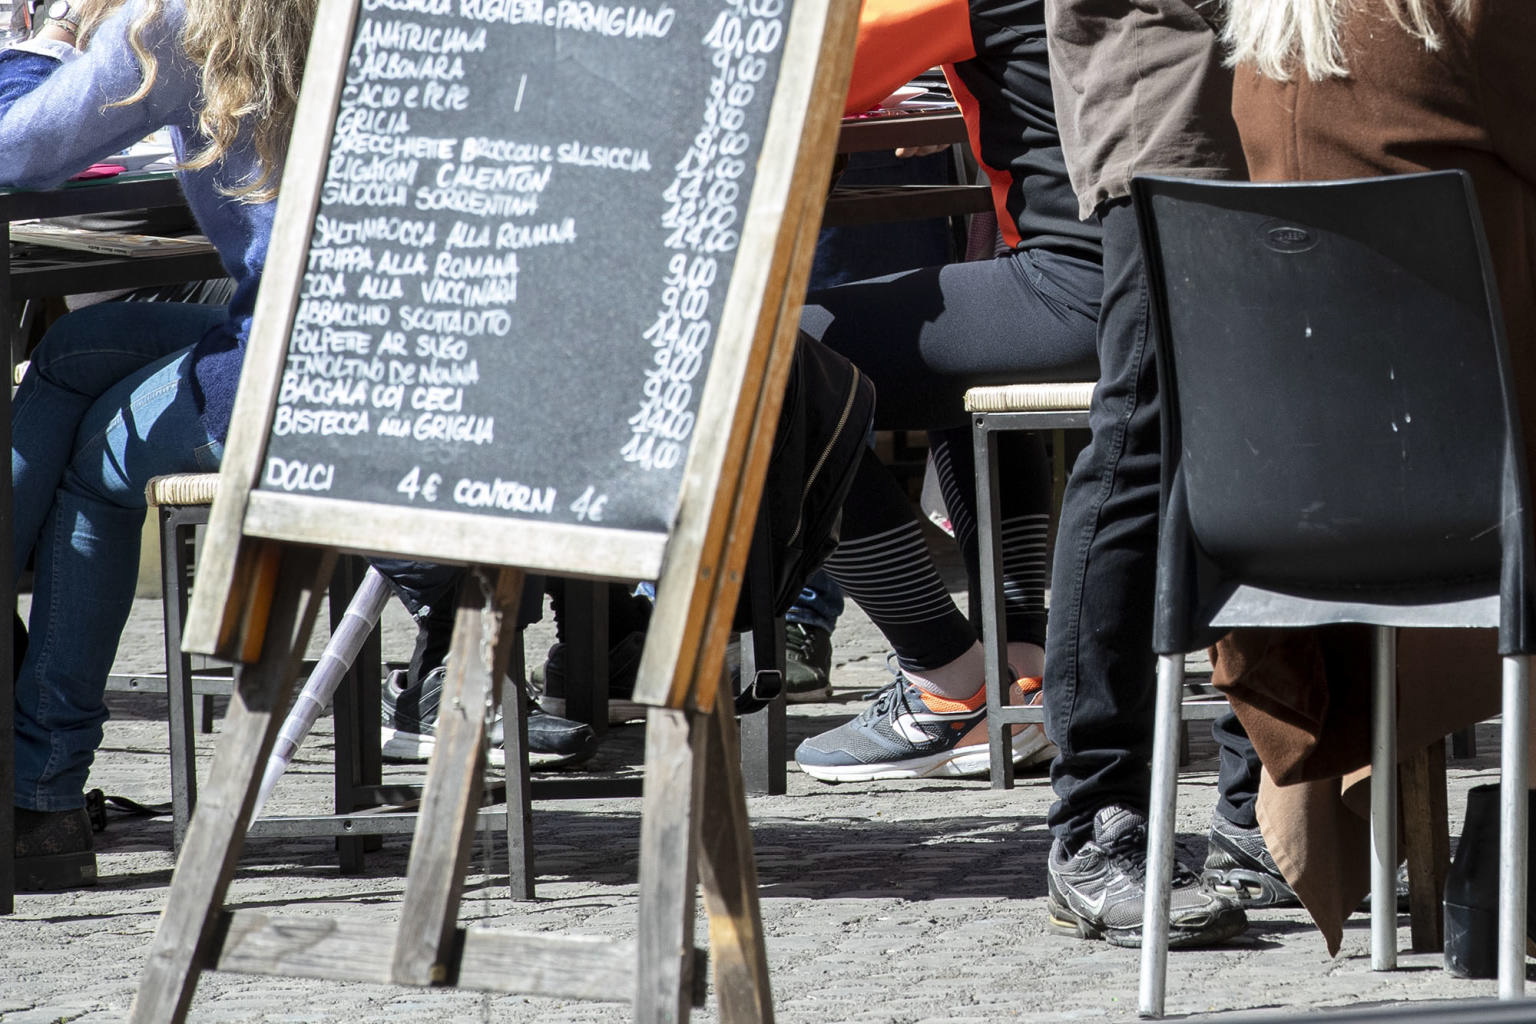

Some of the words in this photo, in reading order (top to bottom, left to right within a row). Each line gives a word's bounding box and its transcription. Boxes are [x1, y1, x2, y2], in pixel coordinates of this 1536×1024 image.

[702, 9, 783, 59] 10,00
[345, 51, 466, 85] CARBONARA
[341, 82, 401, 109] CACIO
[403, 85, 420, 108] e
[335, 107, 412, 135] GRICIA
[327, 154, 420, 186] RIGATONI
[556, 139, 653, 173] SALSICCIA
[320, 181, 408, 207] GNOCCHI
[445, 219, 491, 250] ALLA
[496, 217, 578, 250] ROMANA
[308, 245, 374, 274] TRIPPA
[375, 249, 429, 276] ALLA
[434, 251, 520, 280] ROMANA
[357, 273, 404, 300] ALLA
[294, 299, 391, 328] ABBACCHIO
[376, 330, 408, 357] AR
[415, 333, 469, 361] SUGO
[411, 386, 464, 413] CECI
[272, 404, 370, 436] BISTECCA
[413, 411, 495, 445] GRIGLIA
[265, 457, 335, 492] DOLCI
[453, 477, 557, 514] CONTORNI
